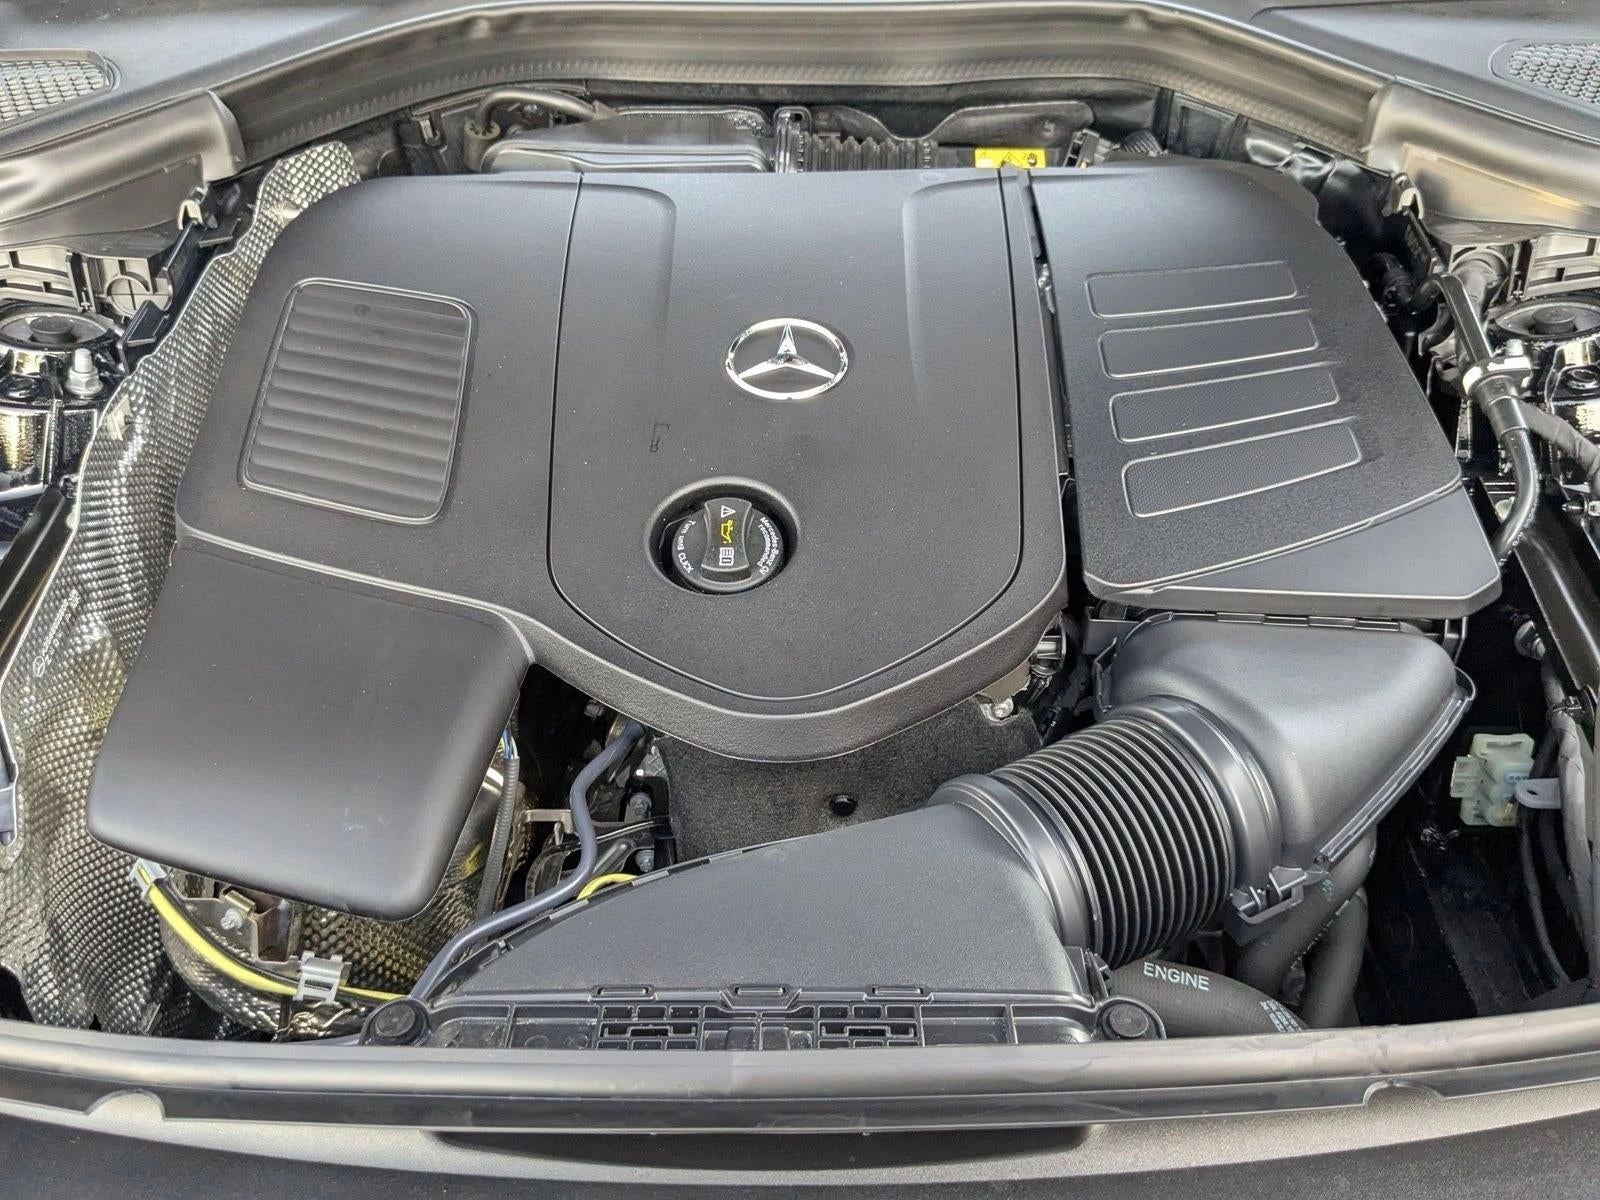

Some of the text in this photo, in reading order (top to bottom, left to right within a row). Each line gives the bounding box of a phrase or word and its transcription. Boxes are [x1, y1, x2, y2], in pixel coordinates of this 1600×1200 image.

[681, 520, 696, 534] Turn
[757, 523, 771, 567] recommended
[758, 516, 779, 576] Mercedes-Benz Oil
[678, 552, 694, 574] CLICK
[1143, 961, 1210, 992] ENGINE
